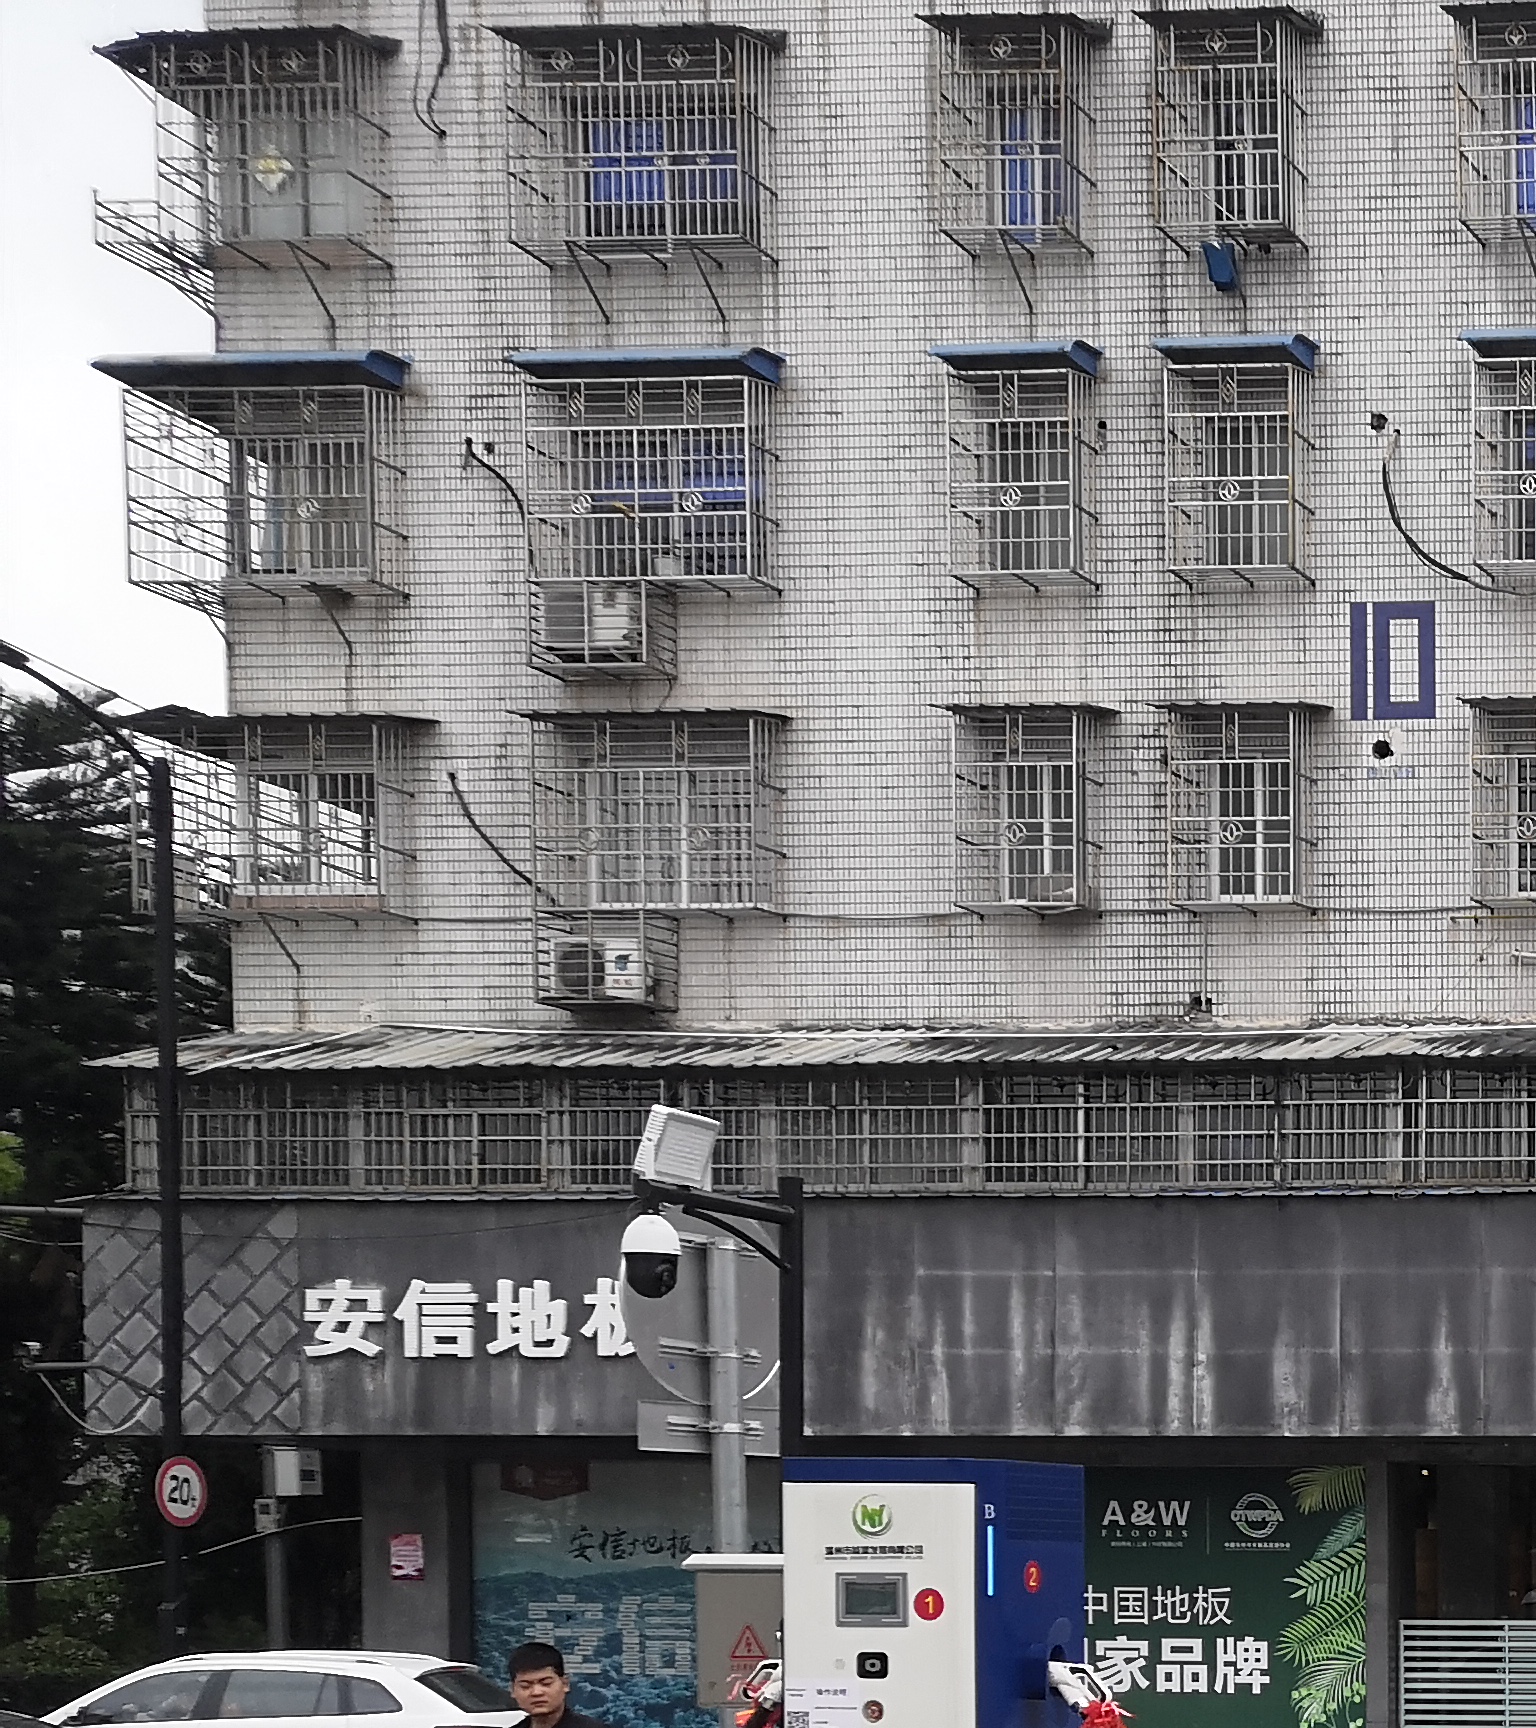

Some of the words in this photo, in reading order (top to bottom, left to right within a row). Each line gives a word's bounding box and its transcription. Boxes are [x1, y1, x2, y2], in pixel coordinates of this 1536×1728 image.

[1350, 601, 1437, 721] 10
[983, 1503, 997, 1520] B
[1101, 1499, 1191, 1526] A&W
[1101, 1529, 1189, 1538] FLOORS
[1083, 1585, 1234, 1626] 中国地板
[1084, 1635, 1271, 1695] 家品牌
